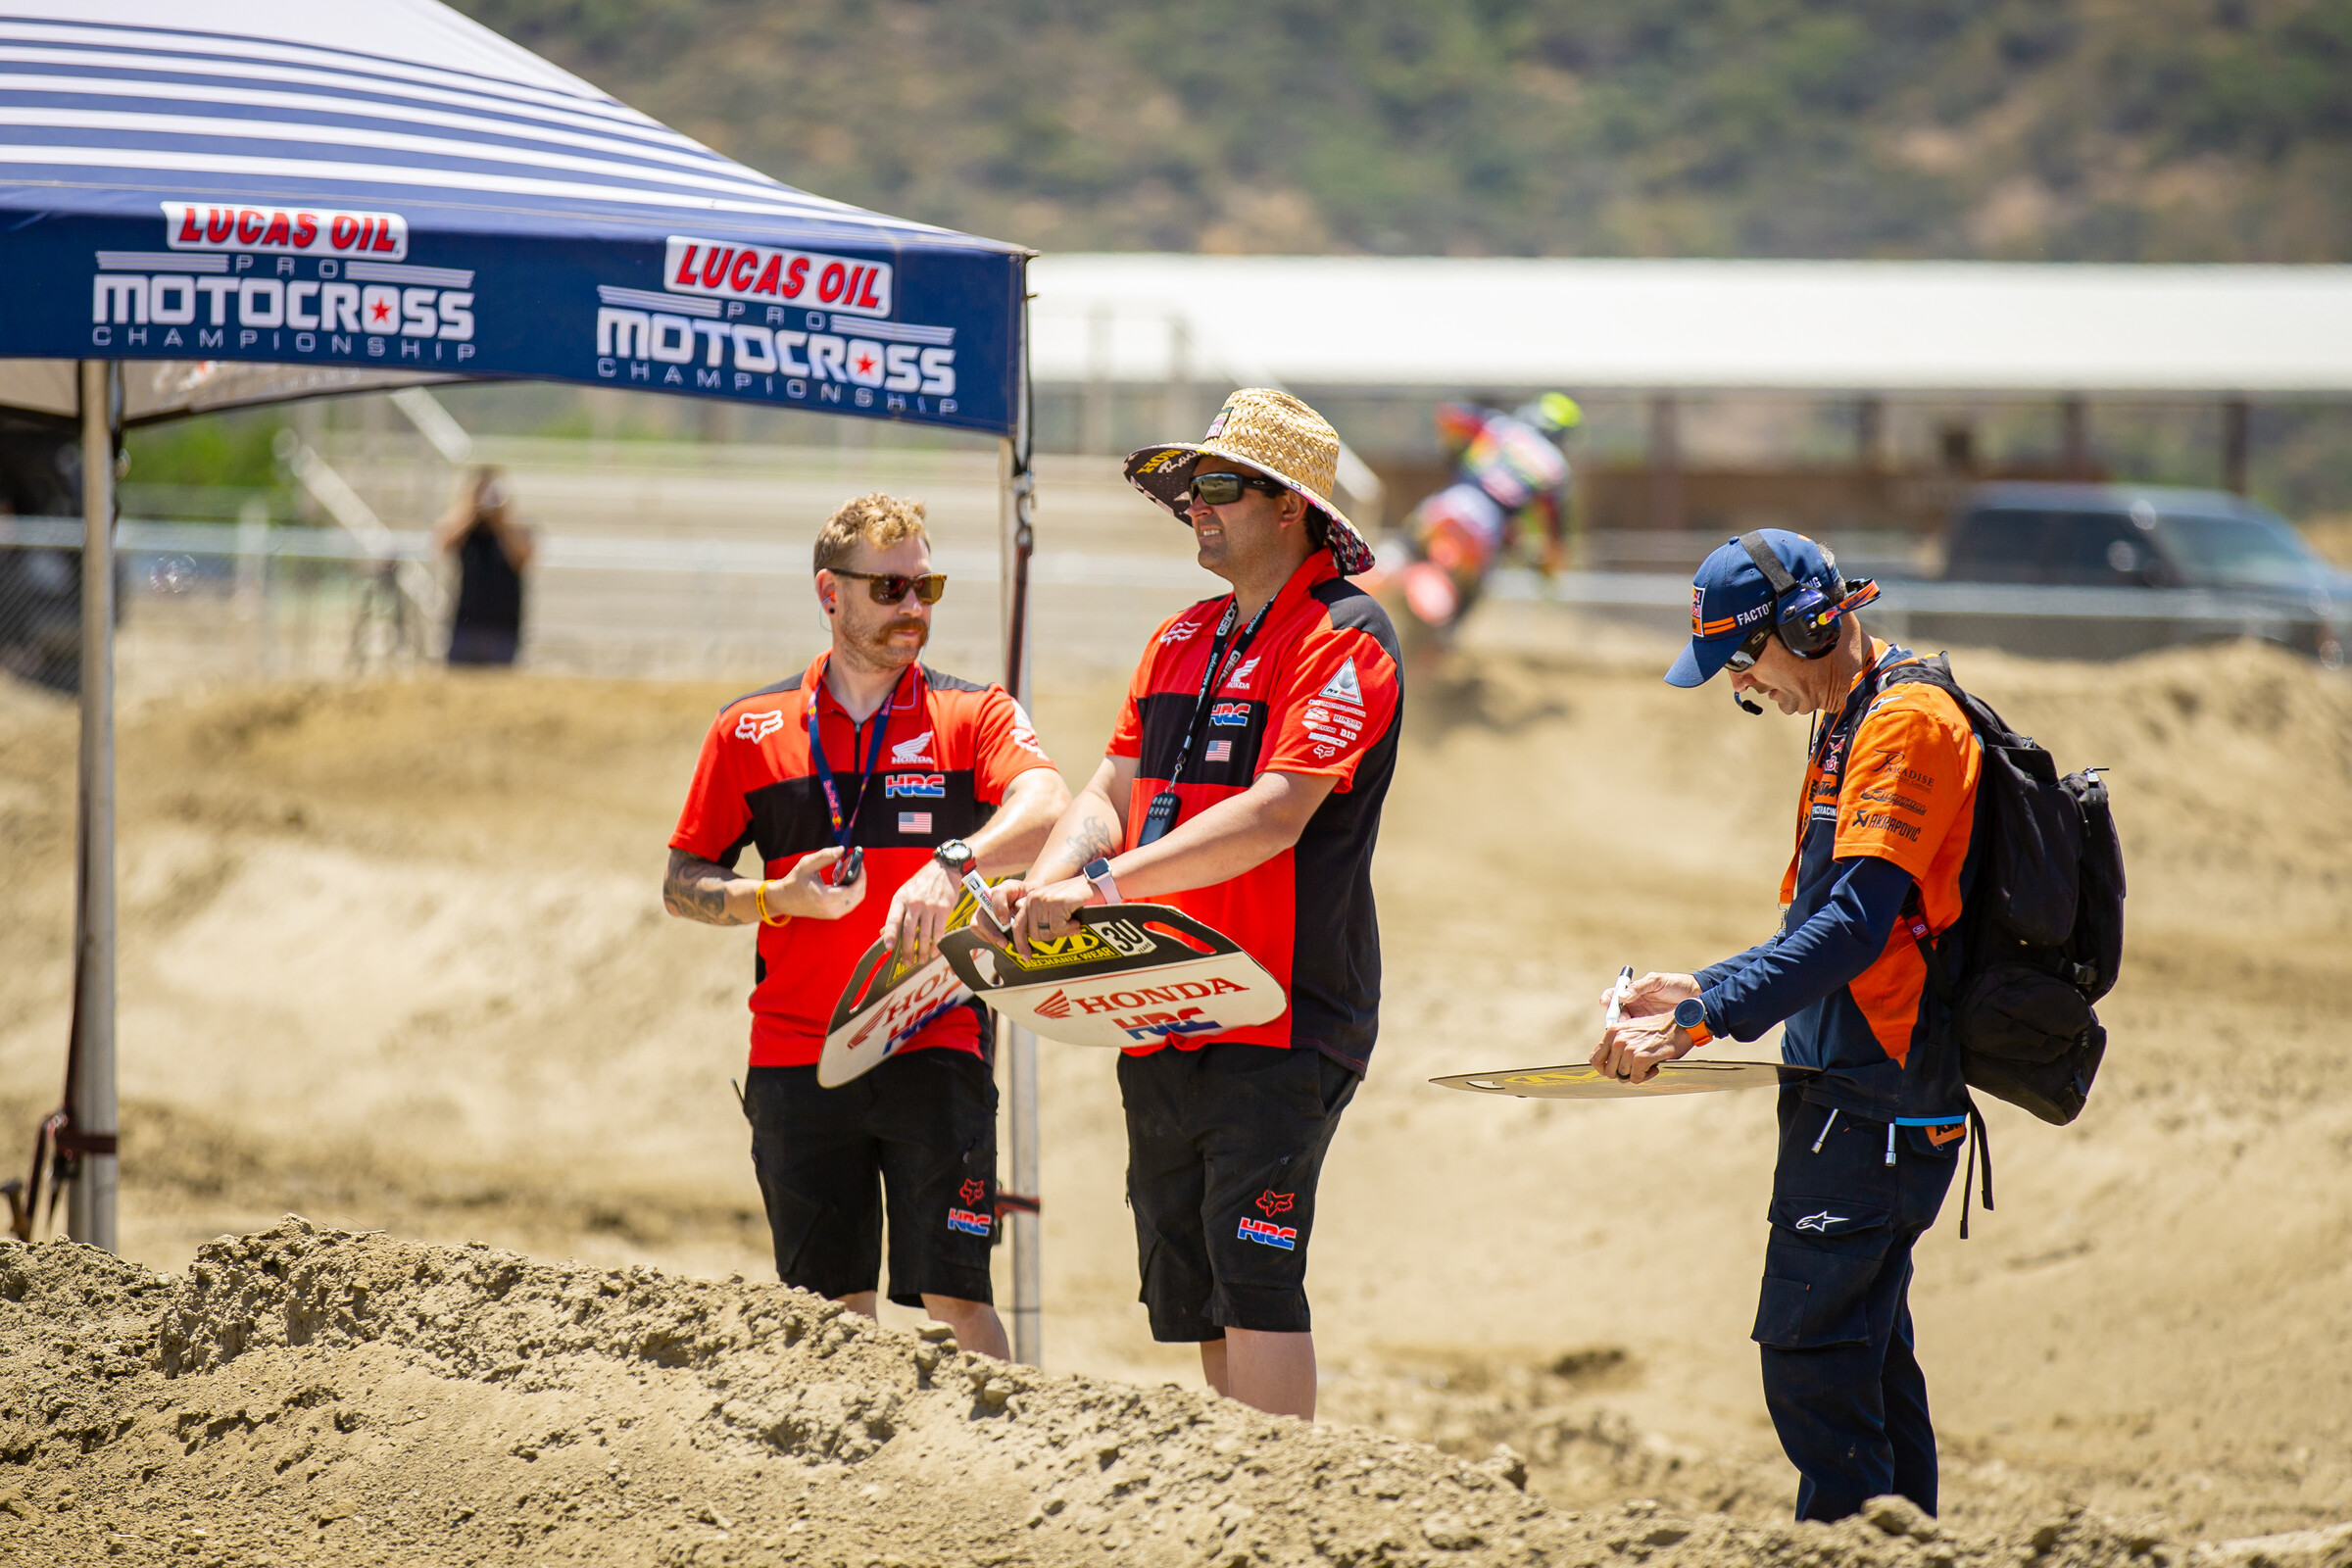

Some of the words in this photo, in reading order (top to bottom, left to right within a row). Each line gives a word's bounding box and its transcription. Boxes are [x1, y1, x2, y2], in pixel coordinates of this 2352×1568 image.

[178, 206, 318, 249] LUCAS
[330, 214, 398, 253] OIL
[235, 254, 339, 278] PRO
[675, 244, 810, 299] LUCAS
[818, 262, 880, 309] OIL
[92, 273, 475, 341] MOTOCROSS
[727, 301, 826, 331] PRO
[92, 326, 476, 363] CHAMPIONSHIP
[596, 307, 956, 396] MOTOCROSS
[597, 357, 958, 416] CHAMPIONSHIP
[1136, 448, 1186, 473] HON
[1216, 601, 1238, 636] GEICO
[1215, 650, 1242, 689] GEIC
[891, 756, 935, 764] HONDA
[1872, 749, 1935, 787] PARADISE
[885, 773, 946, 799] HRC
[1023, 955, 1080, 970] MECHANIX
[1082, 947, 1114, 961] WEAR
[882, 960, 964, 1027] HON
[1071, 977, 1250, 1014] HONDA
